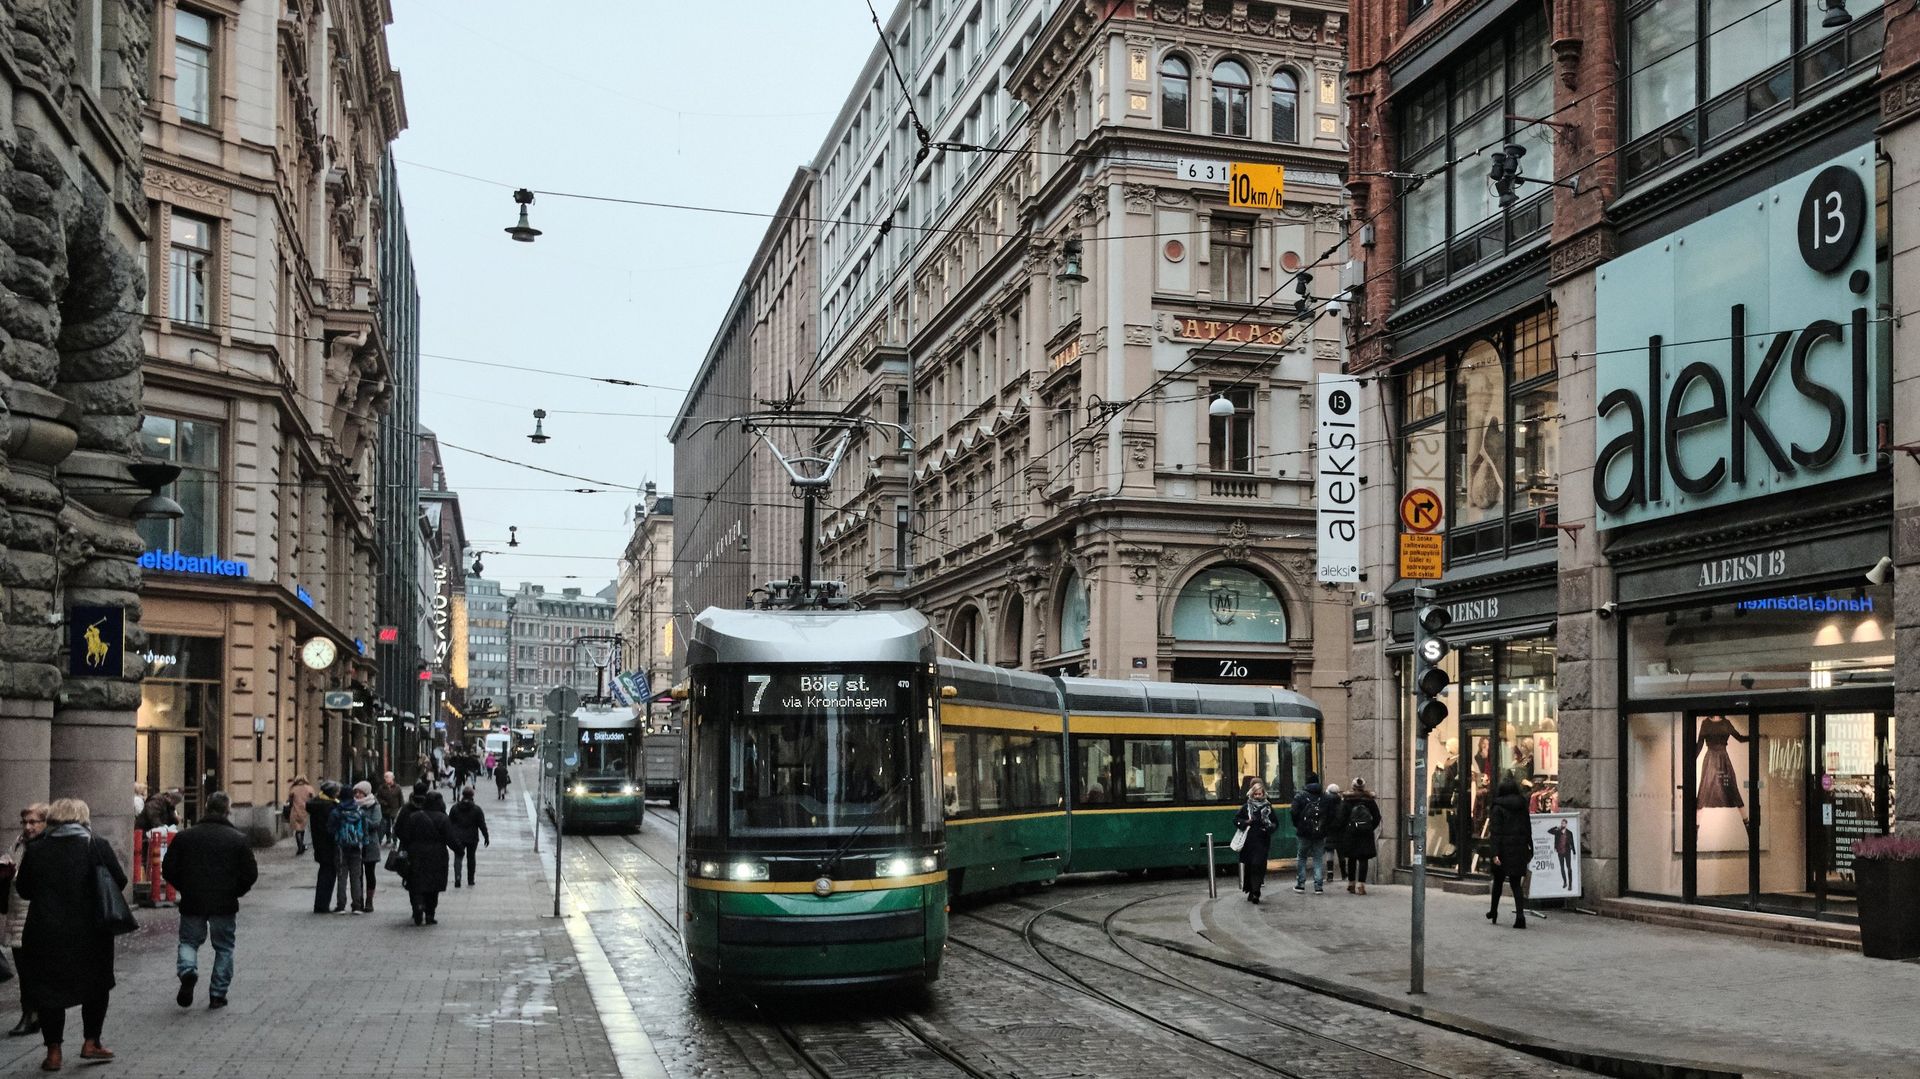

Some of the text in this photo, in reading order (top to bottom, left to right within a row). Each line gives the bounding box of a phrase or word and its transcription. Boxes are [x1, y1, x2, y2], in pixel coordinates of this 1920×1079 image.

[1813, 190, 1846, 250] 13
[1182, 319, 1284, 346] ATLAS
[1593, 269, 1870, 514] aleksi
[1333, 395, 1346, 409] 13
[1320, 421, 1356, 542] aleksi
[1320, 565, 1351, 577] aleksi
[1698, 549, 1785, 587] ALEKSI 13
[1487, 597, 1499, 618] 13
[1424, 640, 1441, 660] S
[1219, 660, 1248, 678] Zio
[747, 674, 771, 713] 7
[800, 675, 870, 692] Böle st.
[782, 695, 887, 710] via Kronohagen
[581, 730, 590, 744] 4
[1532, 860, 1555, 871] -20%
